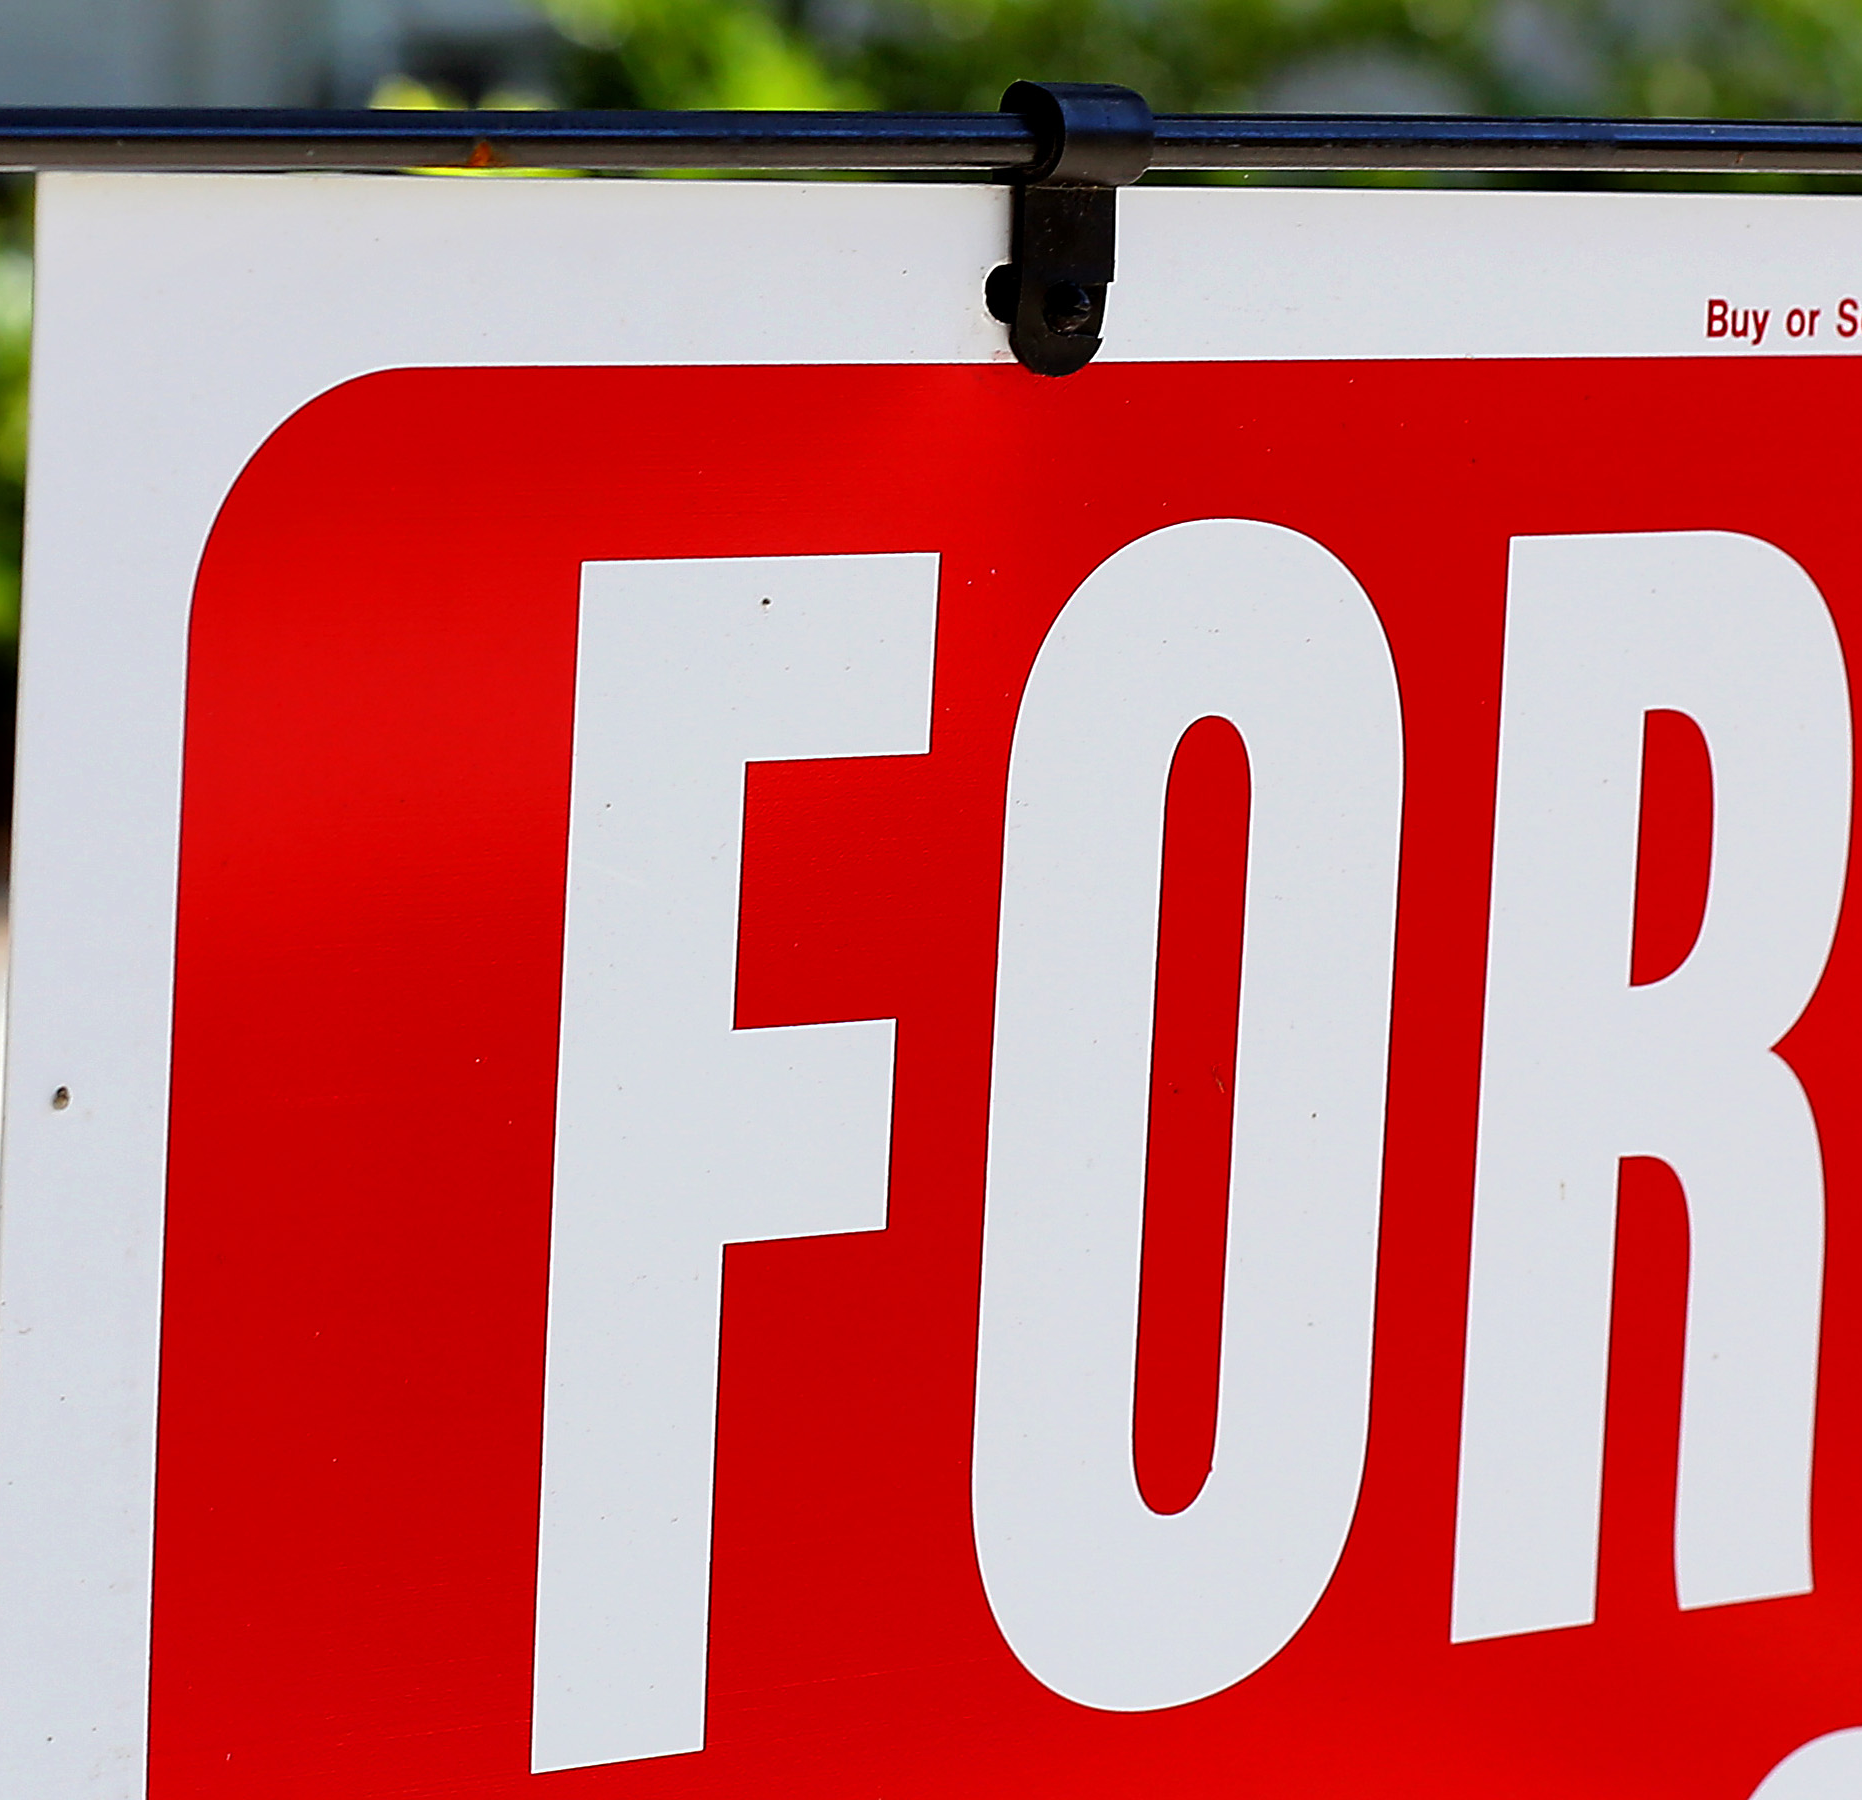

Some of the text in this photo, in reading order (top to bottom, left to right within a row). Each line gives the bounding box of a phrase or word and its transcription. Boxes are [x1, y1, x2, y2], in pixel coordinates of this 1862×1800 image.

[1706, 298, 1770, 346] Buy
[1785, 307, 1822, 338] or
[531, 517, 1853, 1776] FOR
